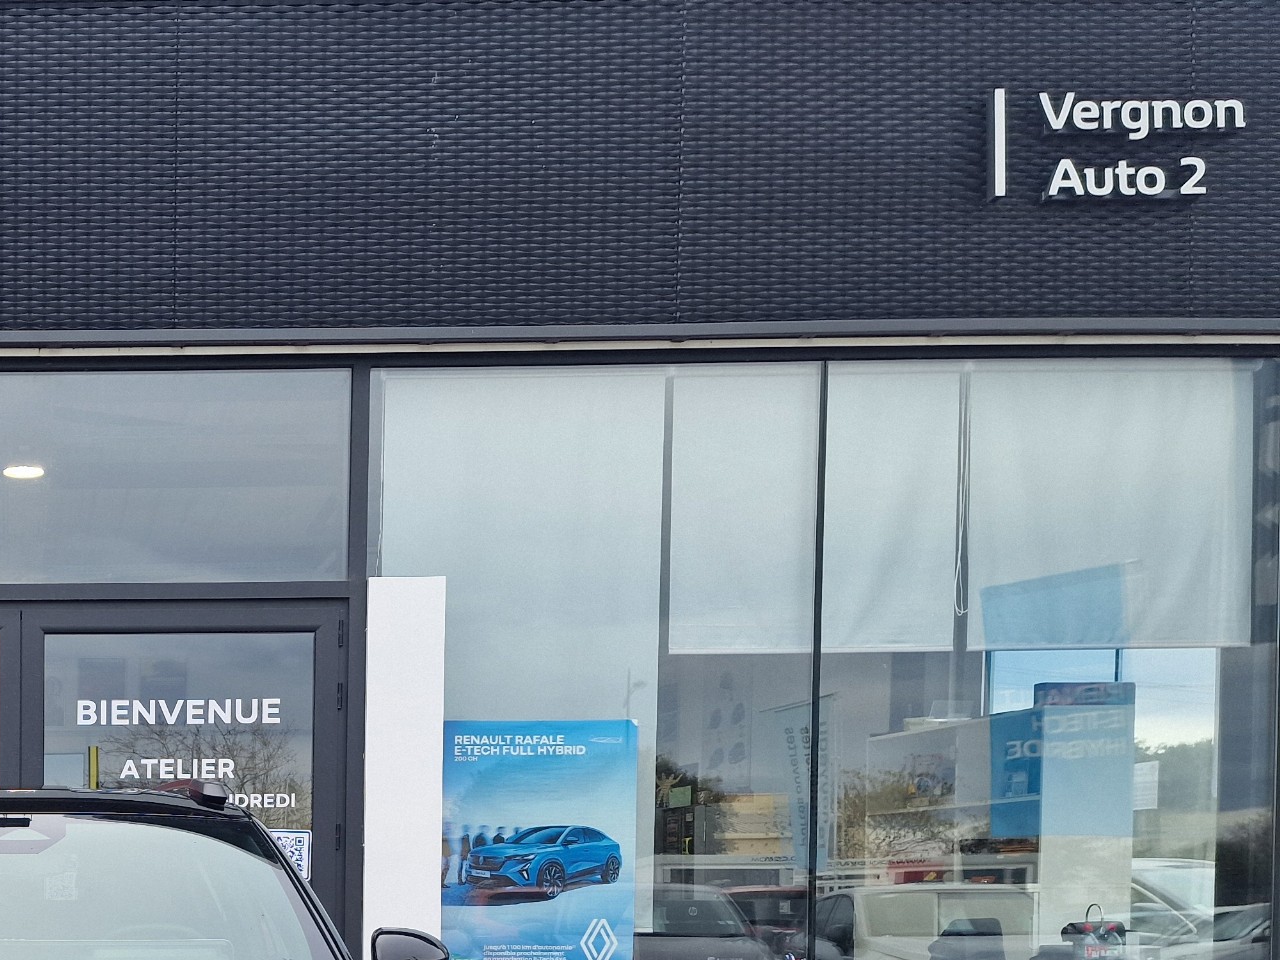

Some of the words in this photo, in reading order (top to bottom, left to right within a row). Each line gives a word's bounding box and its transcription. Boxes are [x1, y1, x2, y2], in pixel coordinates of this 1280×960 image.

[1039, 92, 1246, 140] Vergnon
[1048, 158, 1166, 196] Auto
[1180, 156, 1207, 195] 2
[76, 698, 281, 726] BIENVENUE
[454, 735, 513, 745] RENAULT
[515, 735, 564, 744] RAFALE
[455, 746, 500, 756] E-TECH
[503, 746, 535, 755] FULL
[538, 745, 586, 755] HYBRID
[120, 759, 235, 779] ATELIER
[226, 793, 296, 808] DREDI
